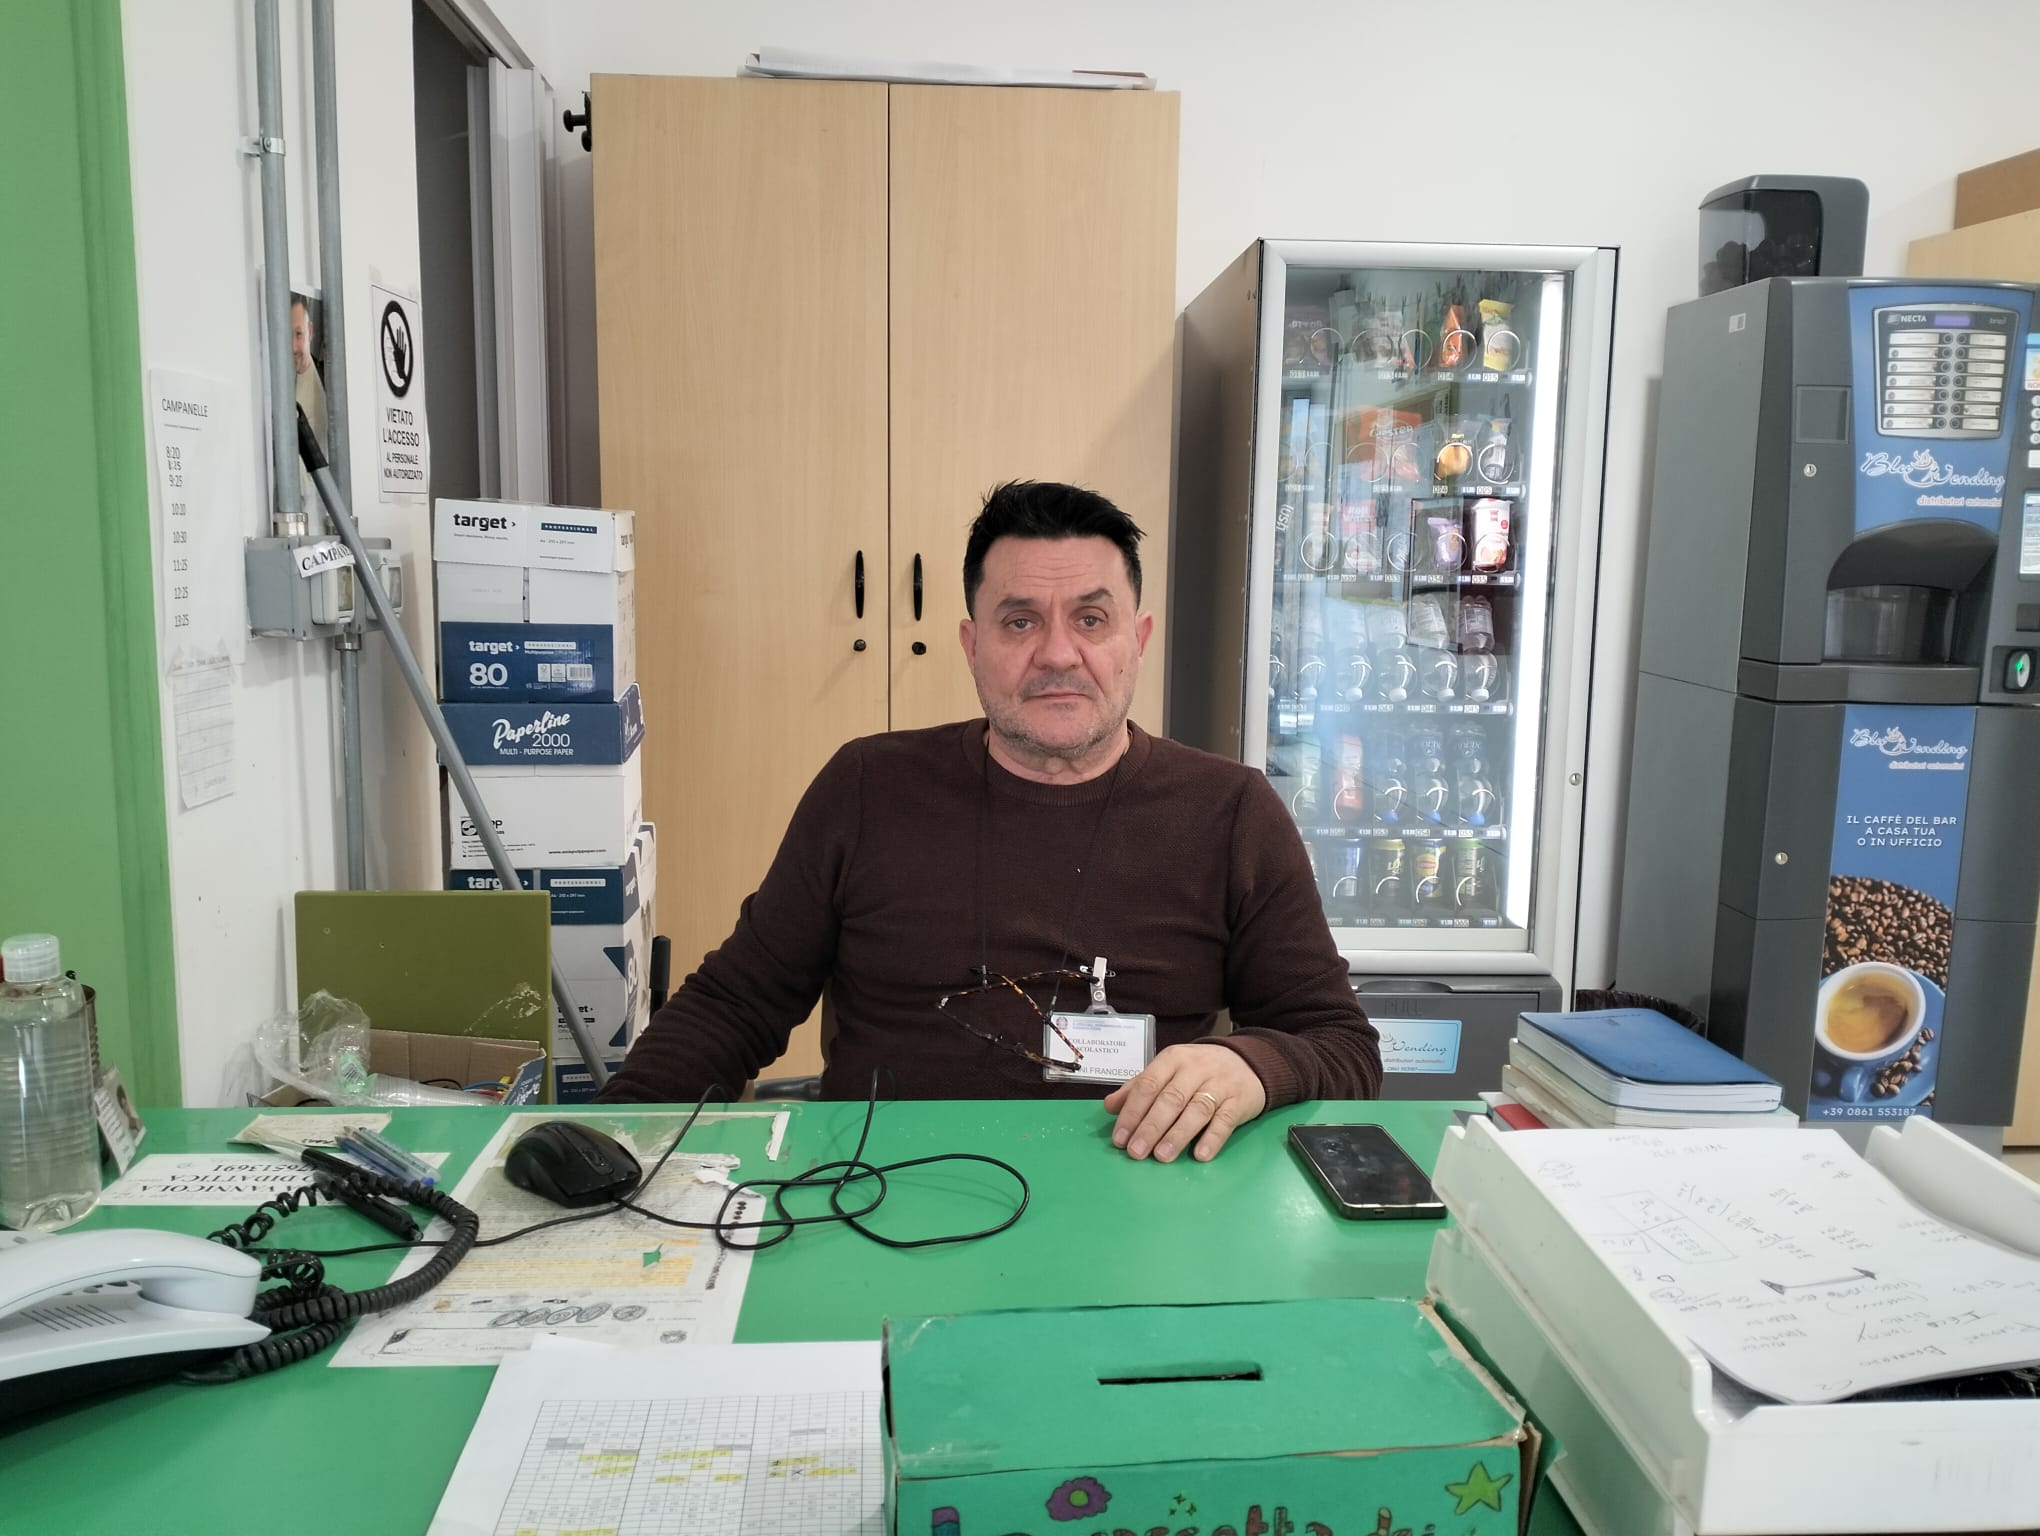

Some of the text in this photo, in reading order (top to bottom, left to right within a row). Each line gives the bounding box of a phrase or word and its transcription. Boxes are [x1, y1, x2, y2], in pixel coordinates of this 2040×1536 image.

[1900, 314, 1927, 323] NECTA
[161, 398, 208, 418] CAMPANELLE
[386, 407, 413, 426] VIETATO
[392, 452, 419, 465] PERSONALE
[453, 513, 507, 532] target
[468, 640, 514, 655] target
[469, 662, 508, 687] 80
[491, 710, 571, 750] Paperline
[532, 733, 571, 748] 2000
[499, 748, 519, 756] MULTI
[523, 748, 553, 756] PURPOSE
[553, 748, 574, 756] PAPER
[1846, 814, 1957, 825] IL CAFFÈ DEL BAR
[1865, 827, 1936, 836] A CASA TUA
[1857, 837, 1943, 847] O IN UFFICIO
[467, 876, 502, 890] targ
[1391, 1040, 1448, 1056] Vending
[1822, 1107, 1917, 1117] +39 0861 553187
[170, 1174, 297, 1182] DIDATTICA
[141, 1184, 276, 1193] VANNICOLA
